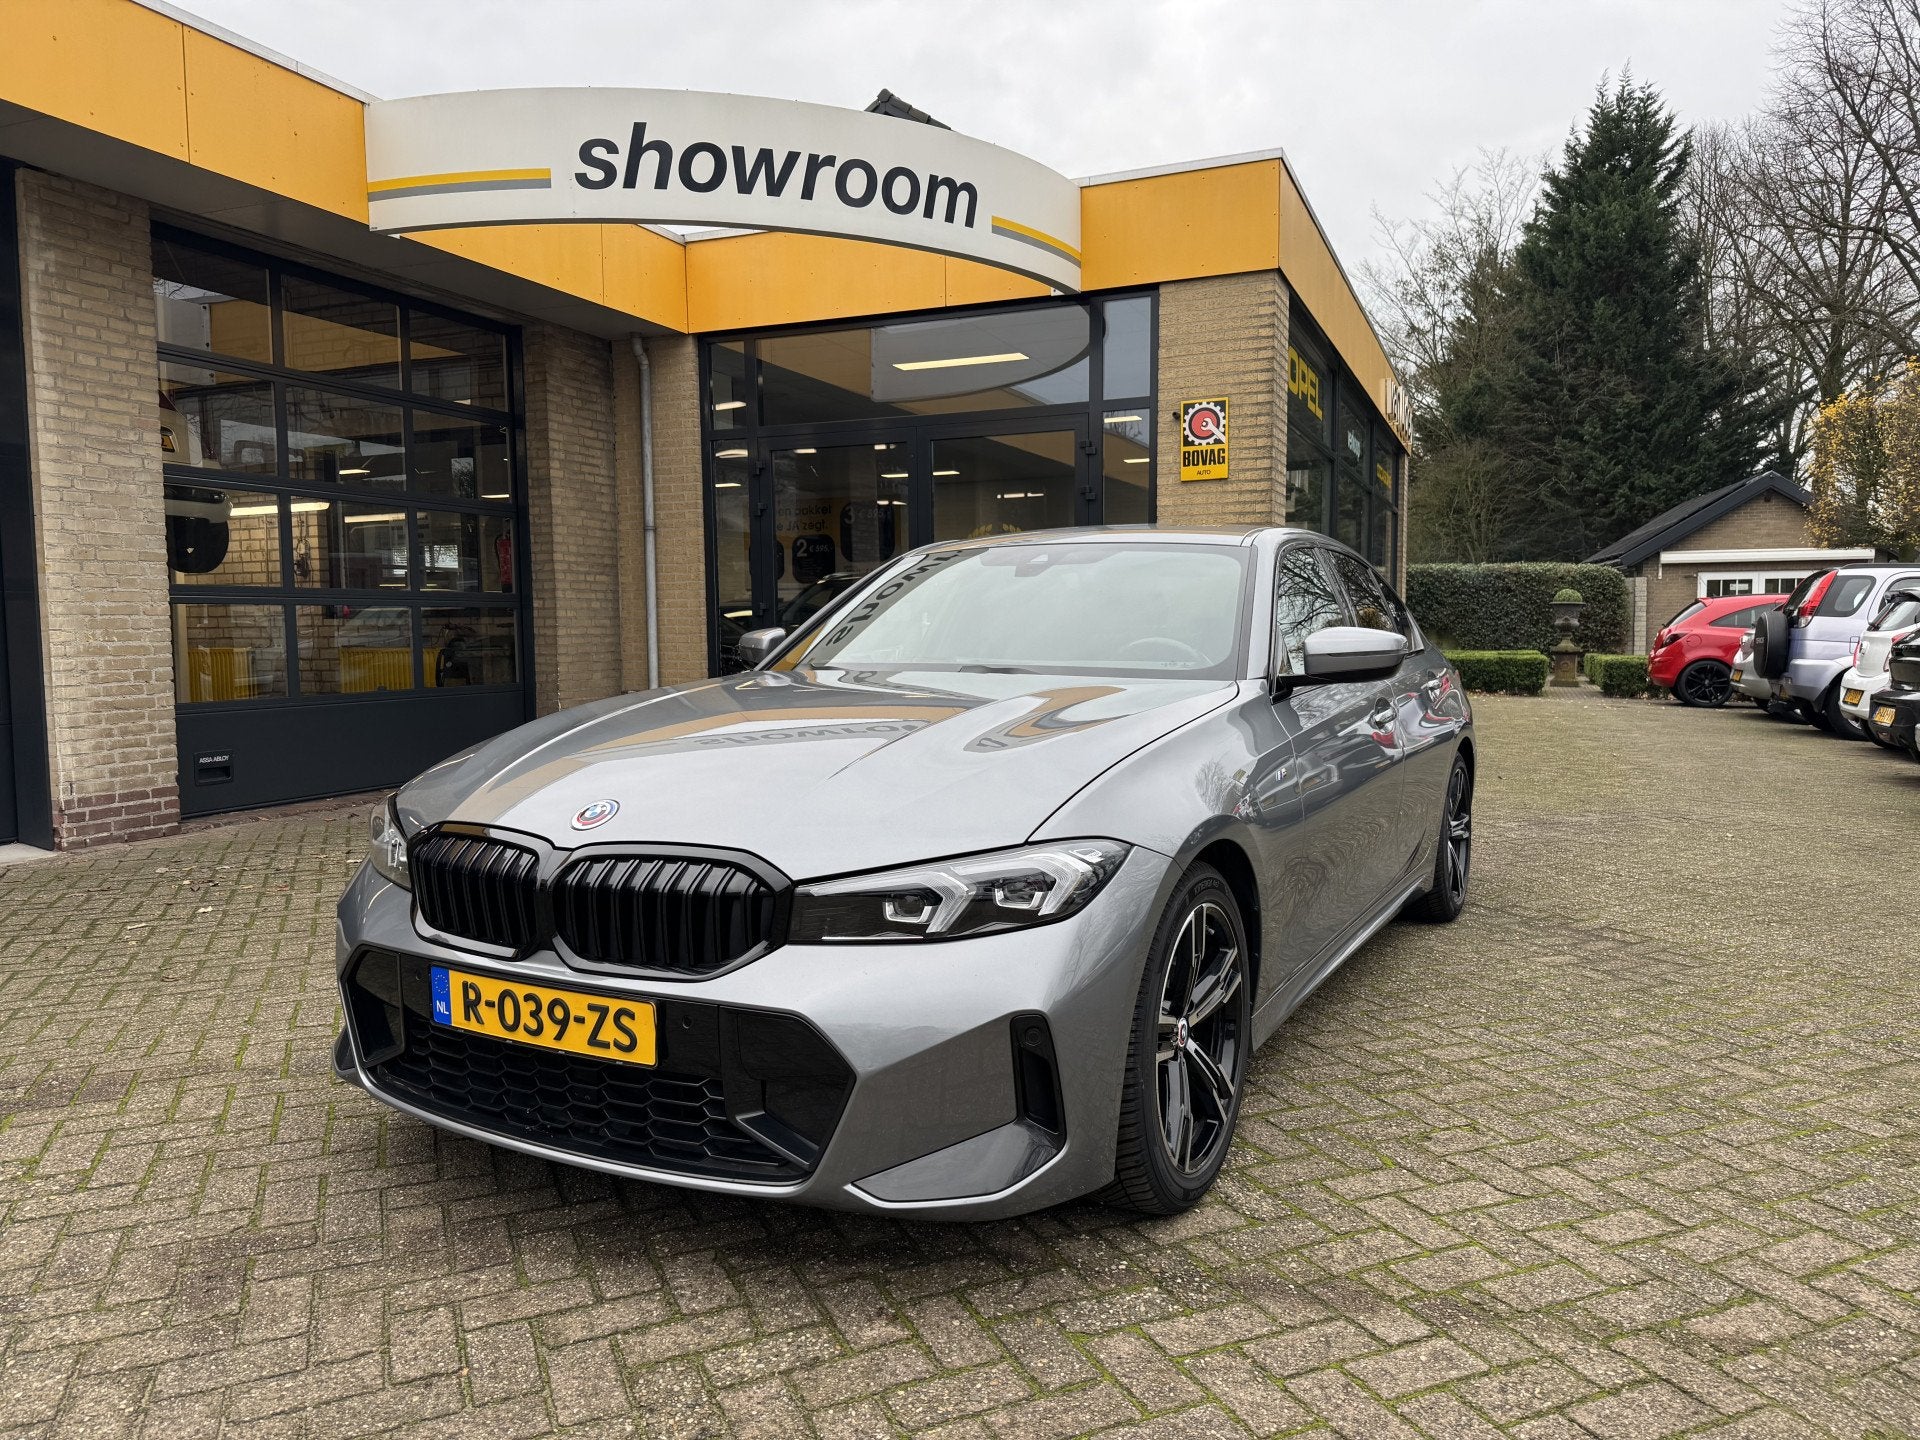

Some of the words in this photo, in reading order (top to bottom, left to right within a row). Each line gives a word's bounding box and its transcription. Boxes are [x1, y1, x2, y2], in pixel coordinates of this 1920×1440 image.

[574, 121, 979, 229] showroom
[1287, 345, 1323, 422] OPEL
[1182, 447, 1226, 467] BOVAG
[843, 506, 856, 524] 3
[796, 538, 808, 557] 2
[436, 1000, 449, 1015] NL
[461, 980, 638, 1053] R-039-ZS
